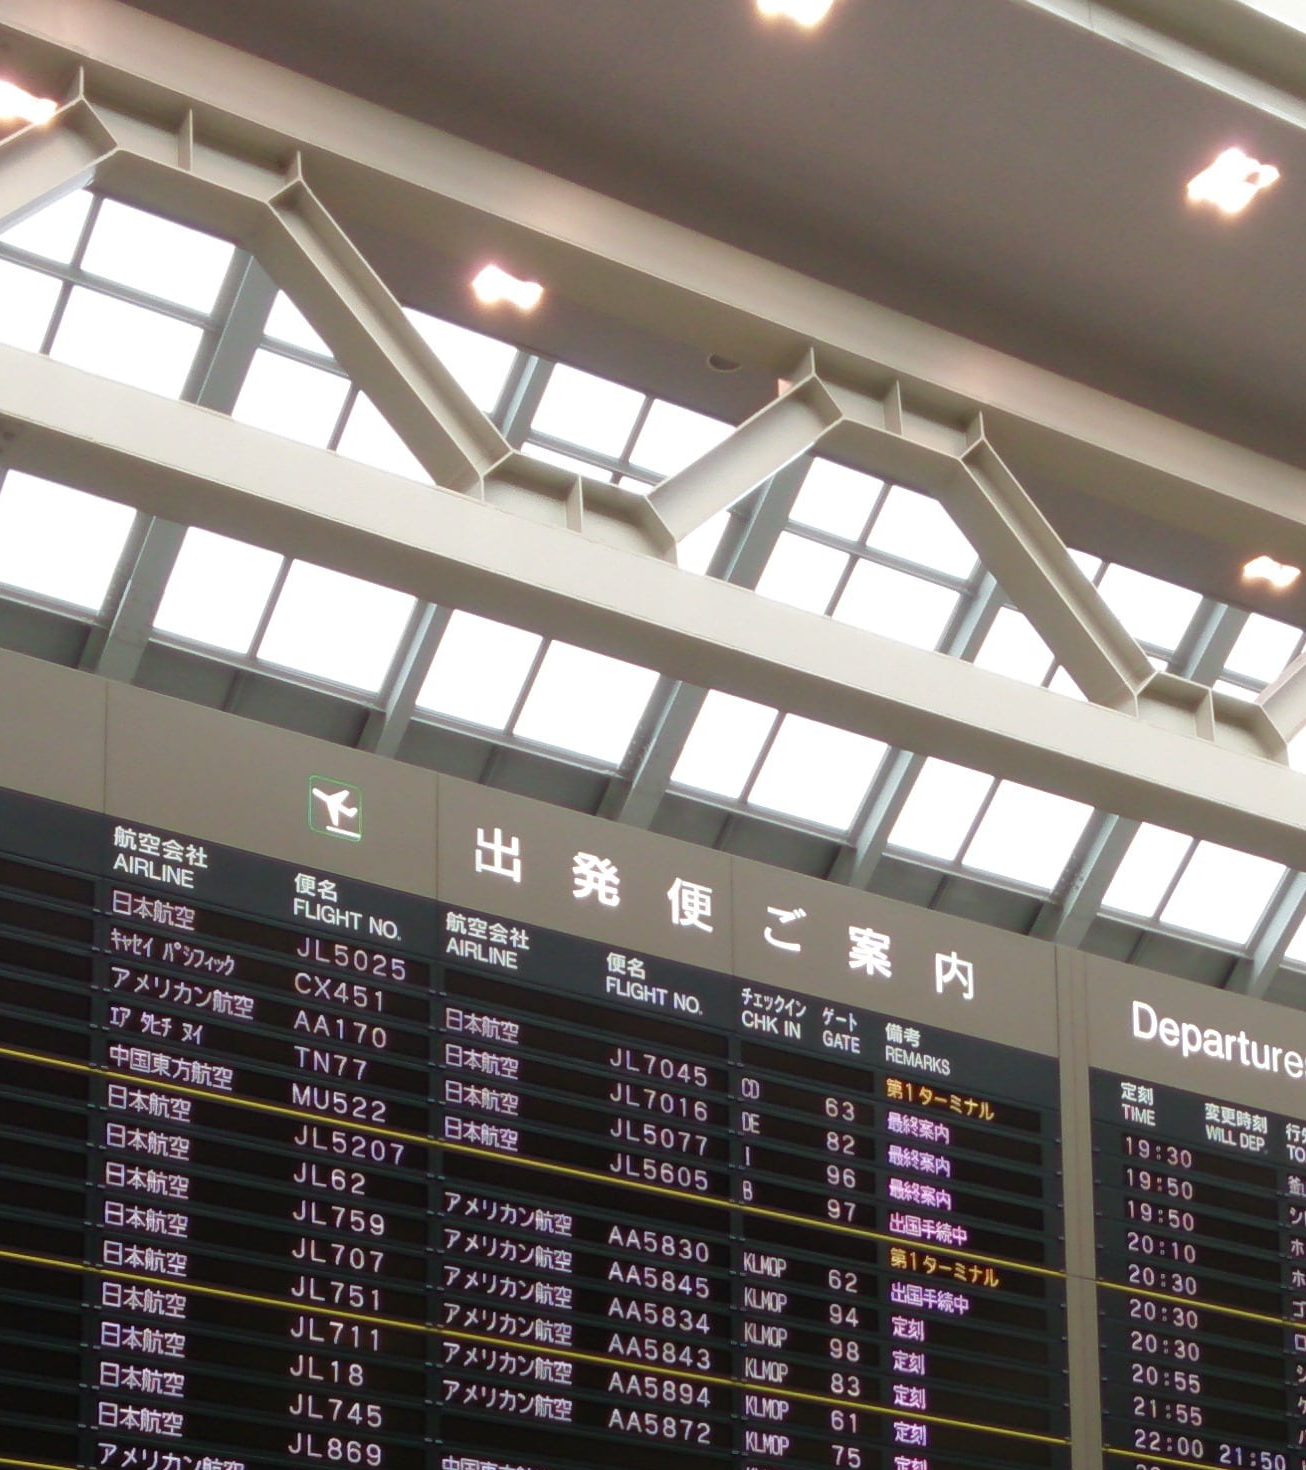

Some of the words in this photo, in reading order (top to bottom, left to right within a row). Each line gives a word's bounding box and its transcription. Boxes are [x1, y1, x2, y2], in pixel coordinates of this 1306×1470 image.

[111, 888, 196, 932] 日本航空
[296, 936, 407, 982] JL5025
[112, 824, 209, 870] 航空会社
[293, 871, 339, 904] 便名
[444, 910, 531, 951] 航空会社
[605, 951, 647, 981] 便名
[740, 986, 808, 1019] チェックイン
[821, 1006, 859, 1033] ゲート
[884, 1021, 922, 1049] 備考
[474, 827, 976, 1001] 出発便ご案内
[112, 852, 196, 890] AIRLINE
[292, 896, 364, 932] FLIGHT
[367, 914, 402, 942] NO.
[445, 935, 519, 971] AIRLINE
[605, 974, 670, 1007] FLIGHT
[672, 990, 704, 1017] NO.
[740, 1008, 779, 1036] CHK
[783, 1019, 802, 1041] IN
[821, 1028, 862, 1055] GATE
[884, 1043, 952, 1077] REMARKS
[110, 965, 255, 1021] アメリカン航空
[292, 1009, 388, 1050] AA170
[293, 971, 383, 1013] CX451
[609, 1047, 709, 1088] JL7045
[824, 1096, 856, 1123] 63
[108, 1042, 234, 1092] 中国東方航空
[291, 1082, 387, 1124] MU522
[293, 1044, 369, 1082] TN77
[1125, 1135, 1193, 1169] 19:30
[291, 1199, 386, 1237] JL759
[292, 1161, 366, 1196] JL62
[607, 1224, 711, 1264] AA5830
[1126, 1230, 1197, 1265] 20:10
[289, 1315, 379, 1352] JL711
[1132, 1395, 1204, 1428] 21:55
[1133, 1427, 1204, 1460] 22:00
